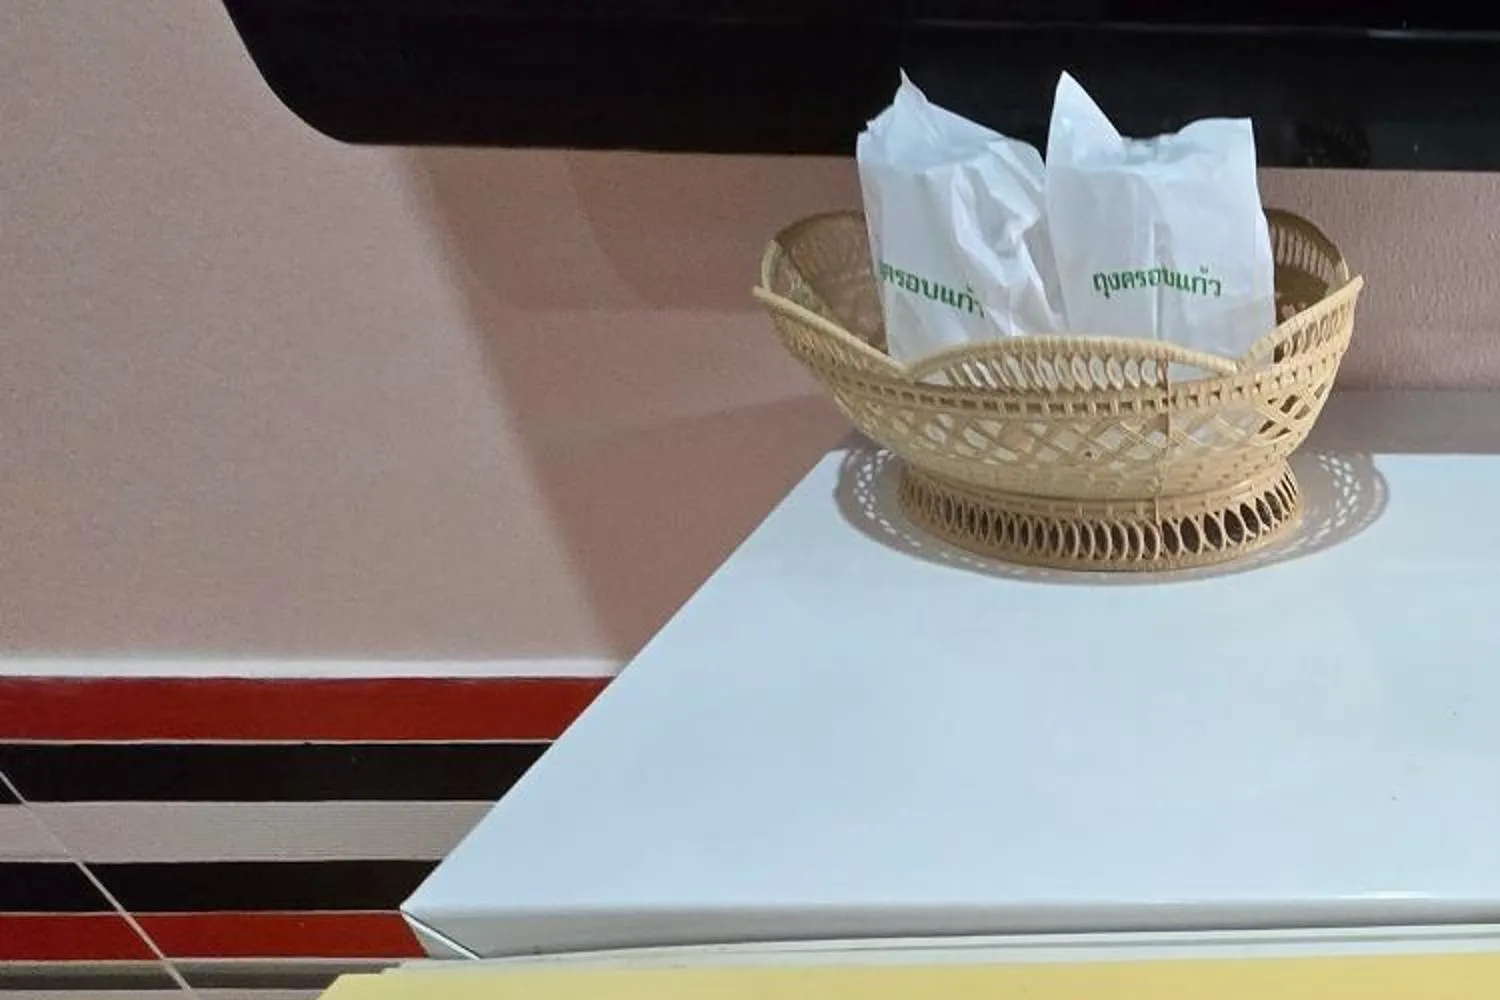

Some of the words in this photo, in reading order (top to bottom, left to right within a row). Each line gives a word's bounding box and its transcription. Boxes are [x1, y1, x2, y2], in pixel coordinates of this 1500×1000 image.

[1092, 264, 1221, 299] ถุงครอบแก้ว
